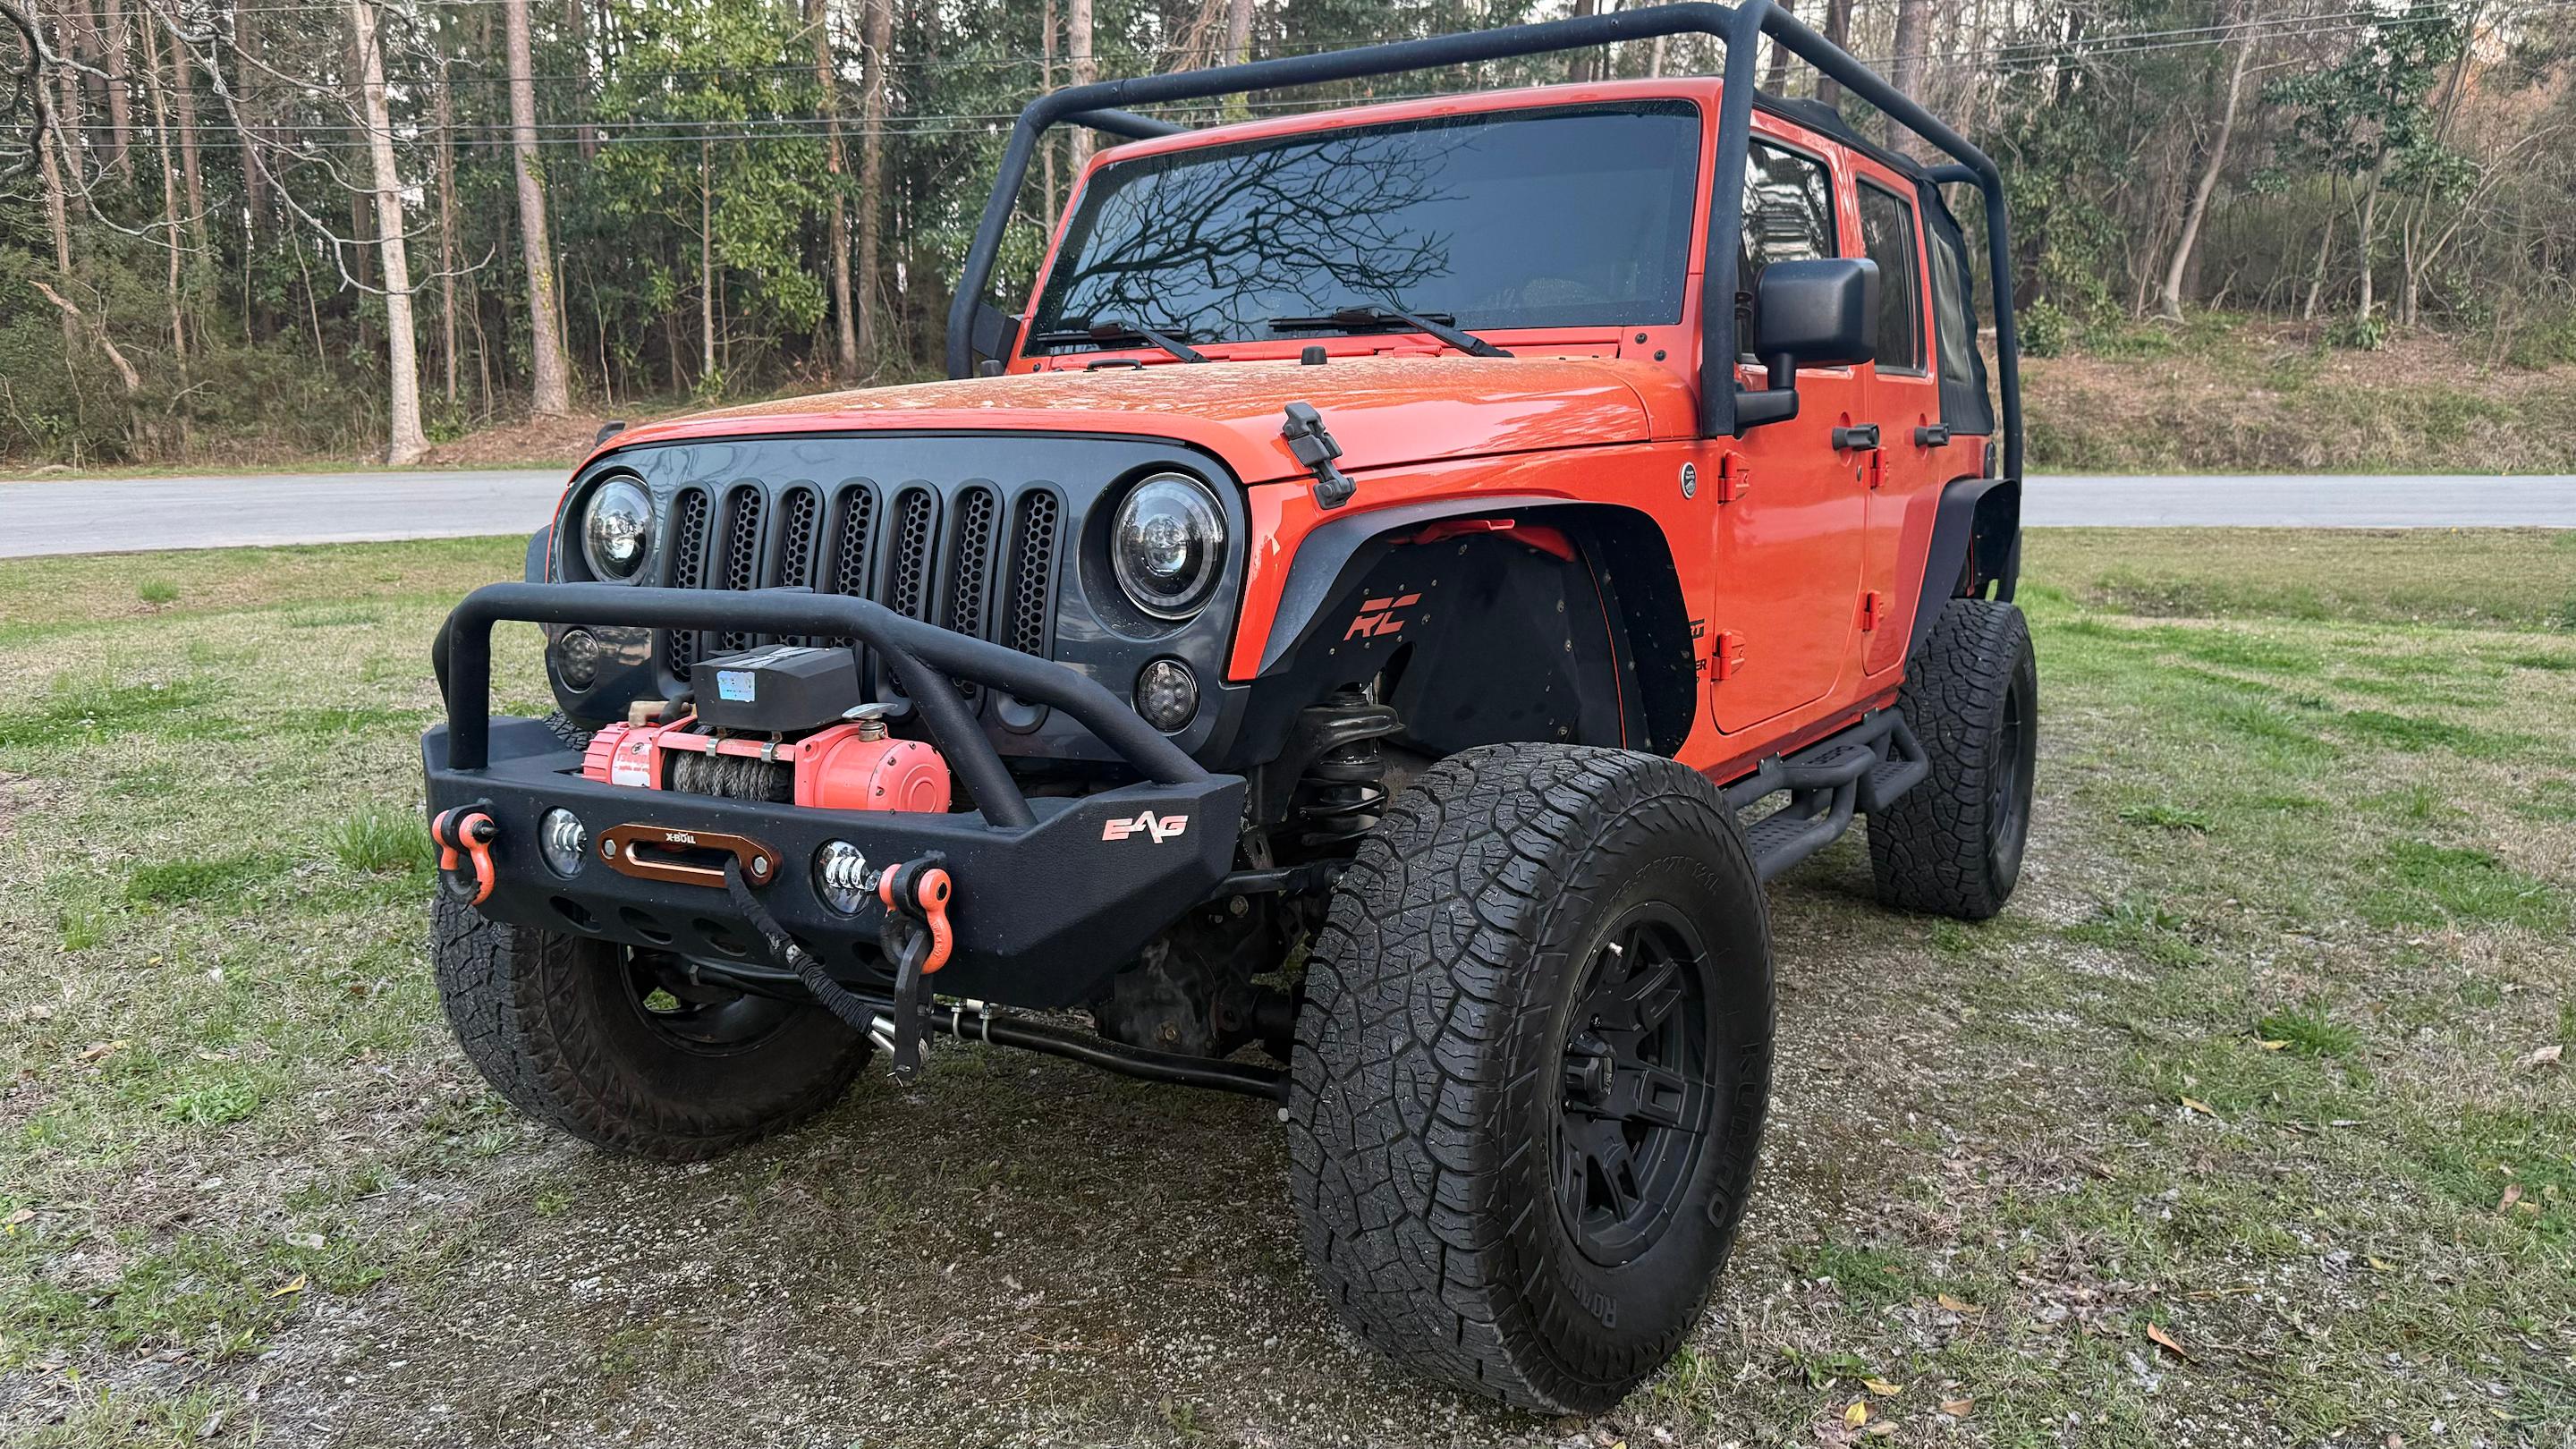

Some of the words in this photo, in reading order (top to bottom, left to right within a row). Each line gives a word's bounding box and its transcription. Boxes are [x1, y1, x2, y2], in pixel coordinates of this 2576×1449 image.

[1343, 593, 1422, 641] RC
[665, 832, 696, 844] X-BULL
[1102, 810, 1189, 843] EAG
